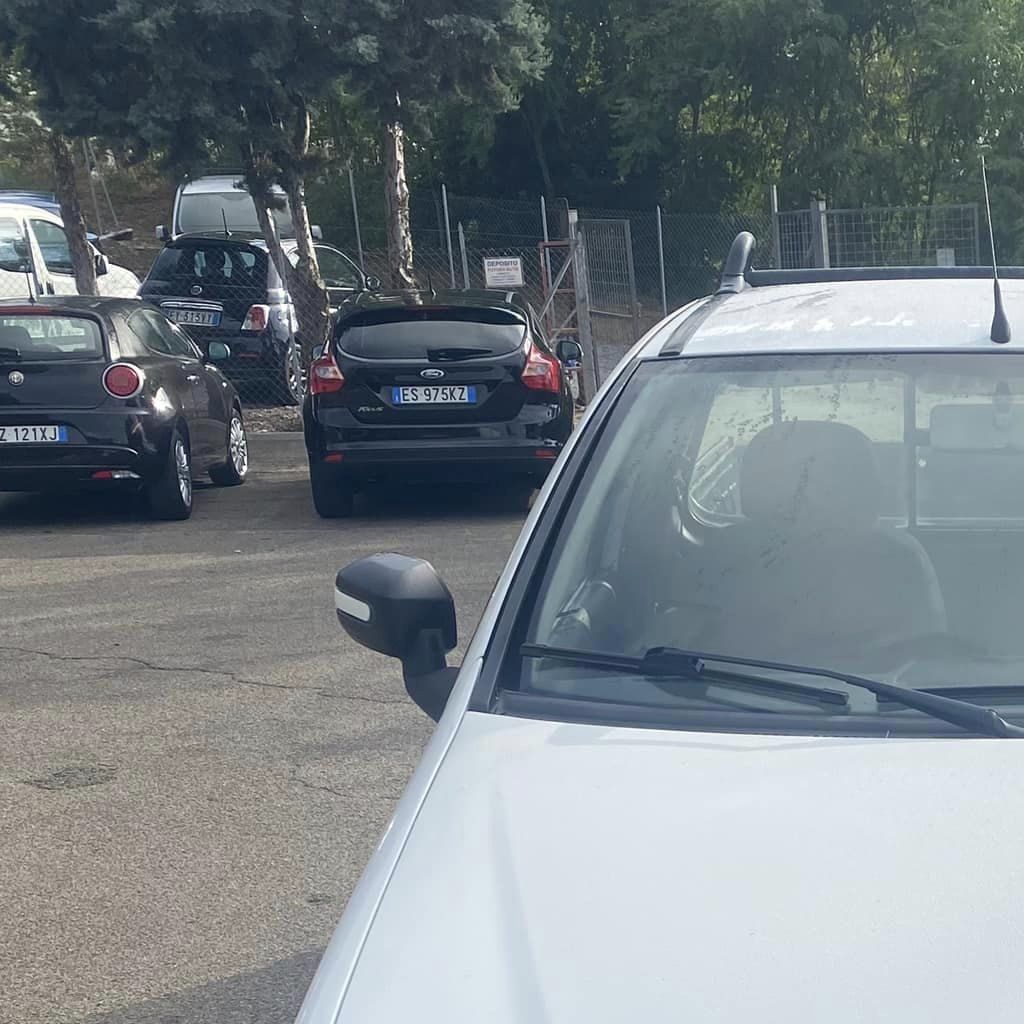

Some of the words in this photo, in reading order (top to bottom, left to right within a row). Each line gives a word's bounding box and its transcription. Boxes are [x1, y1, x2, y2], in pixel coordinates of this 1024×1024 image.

[402, 387, 418, 401] ES
[424, 387, 467, 402] 975KZ
[14, 427, 57, 441] 121XJ
